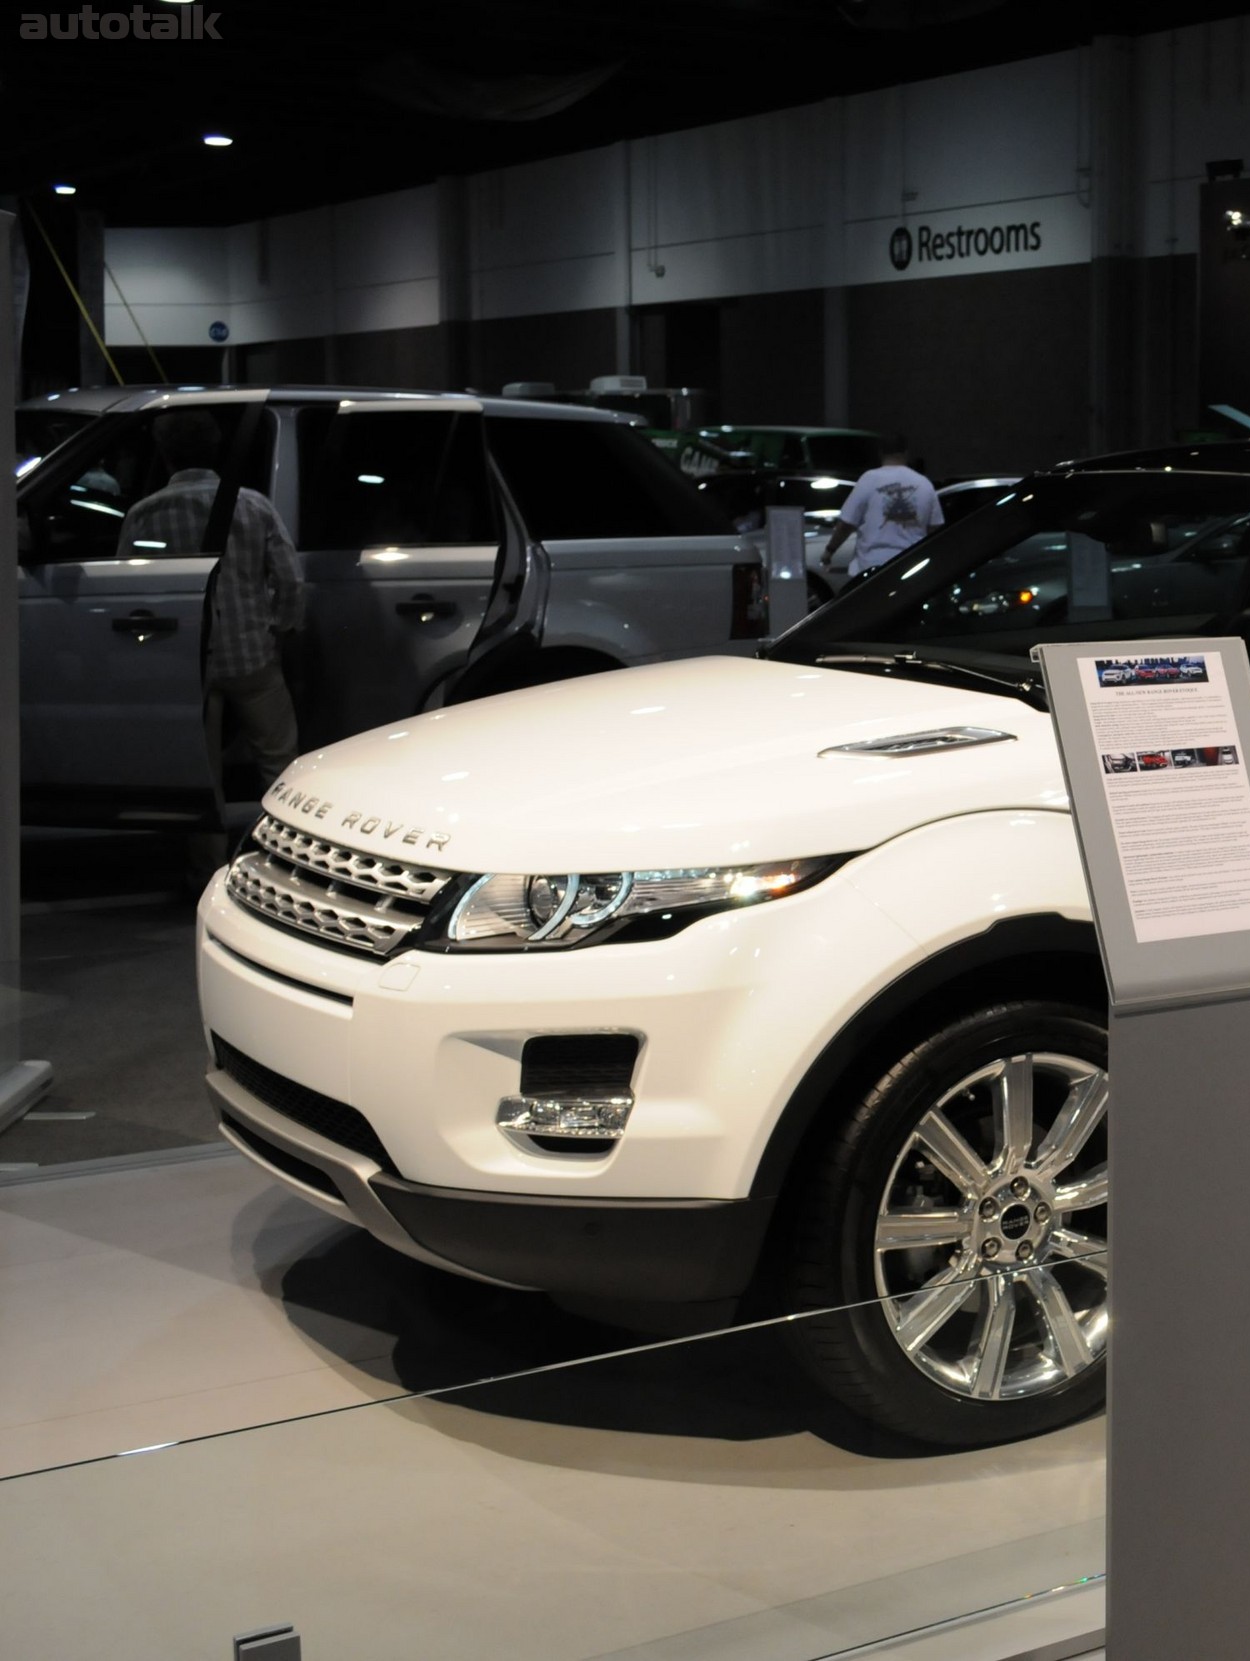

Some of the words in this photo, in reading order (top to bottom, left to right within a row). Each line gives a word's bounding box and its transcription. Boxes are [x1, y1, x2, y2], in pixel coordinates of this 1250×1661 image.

[918, 222, 1041, 262] Restrooms
[271, 782, 333, 819] RANGE
[341, 811, 451, 852] ROVER
